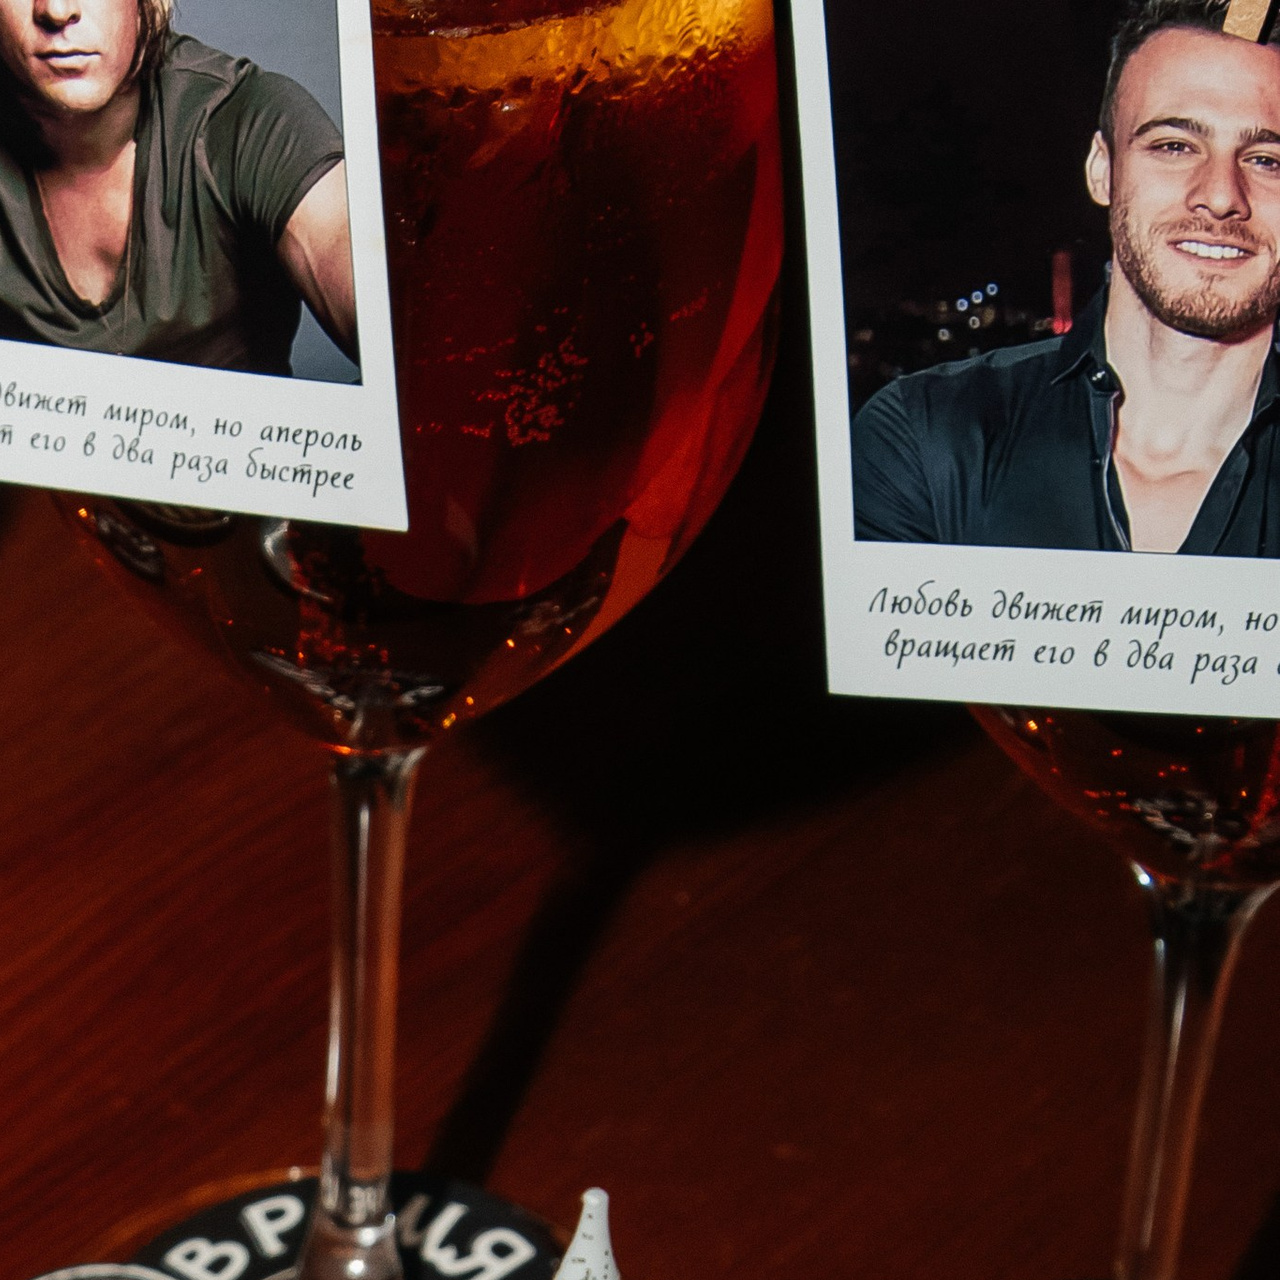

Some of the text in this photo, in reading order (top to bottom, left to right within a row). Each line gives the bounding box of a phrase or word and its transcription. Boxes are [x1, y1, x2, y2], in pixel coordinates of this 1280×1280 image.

[103, 401, 196, 437] миром,
[213, 417, 243, 439] но
[259, 425, 364, 457] апероль
[30, 433, 67, 453] его
[83, 431, 96, 456] в
[112, 434, 154, 466] два
[169, 447, 228, 483] раза
[245, 447, 355, 497] быстрее
[868, 580, 1279, 639] Любовь движет миром, но
[884, 628, 1016, 670] вращает
[1033, 642, 1075, 665] его
[1093, 638, 1110, 667] в
[1126, 639, 1175, 671] два
[1189, 649, 1259, 685] раза
